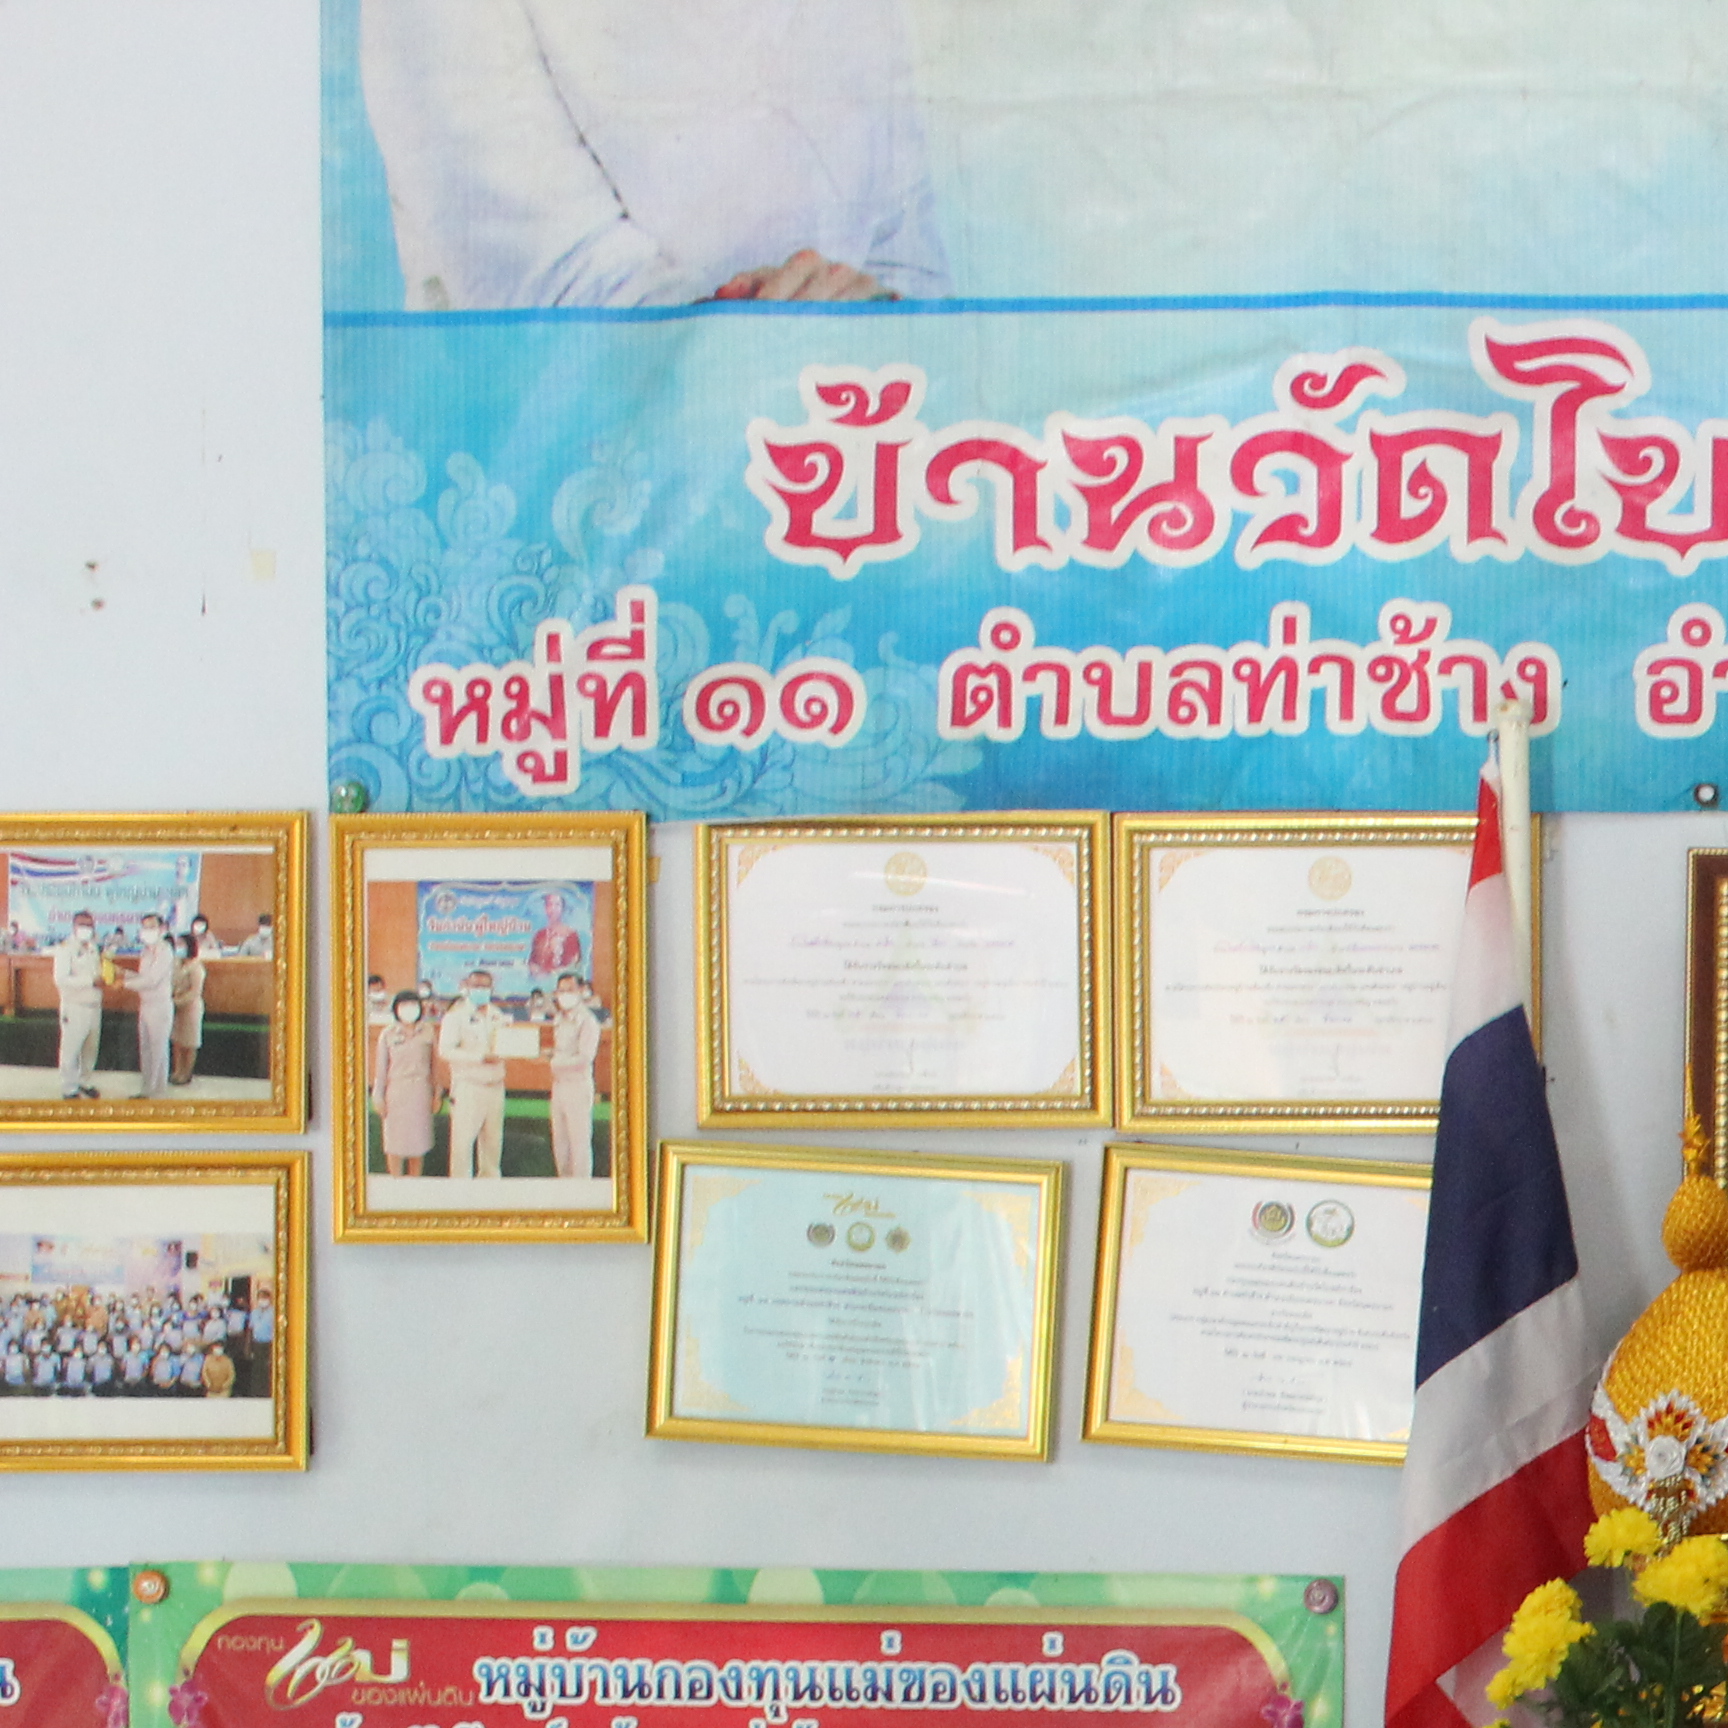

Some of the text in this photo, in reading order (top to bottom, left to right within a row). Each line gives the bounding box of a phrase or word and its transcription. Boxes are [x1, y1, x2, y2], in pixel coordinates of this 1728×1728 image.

[425, 602, 646, 783] หมู่ที่
[953, 615, 1547, 722] ตำบลท่าช้าง
[474, 1628, 1178, 1719] หมู่บ้านกองทุนแม่ของแผ่นดิน
